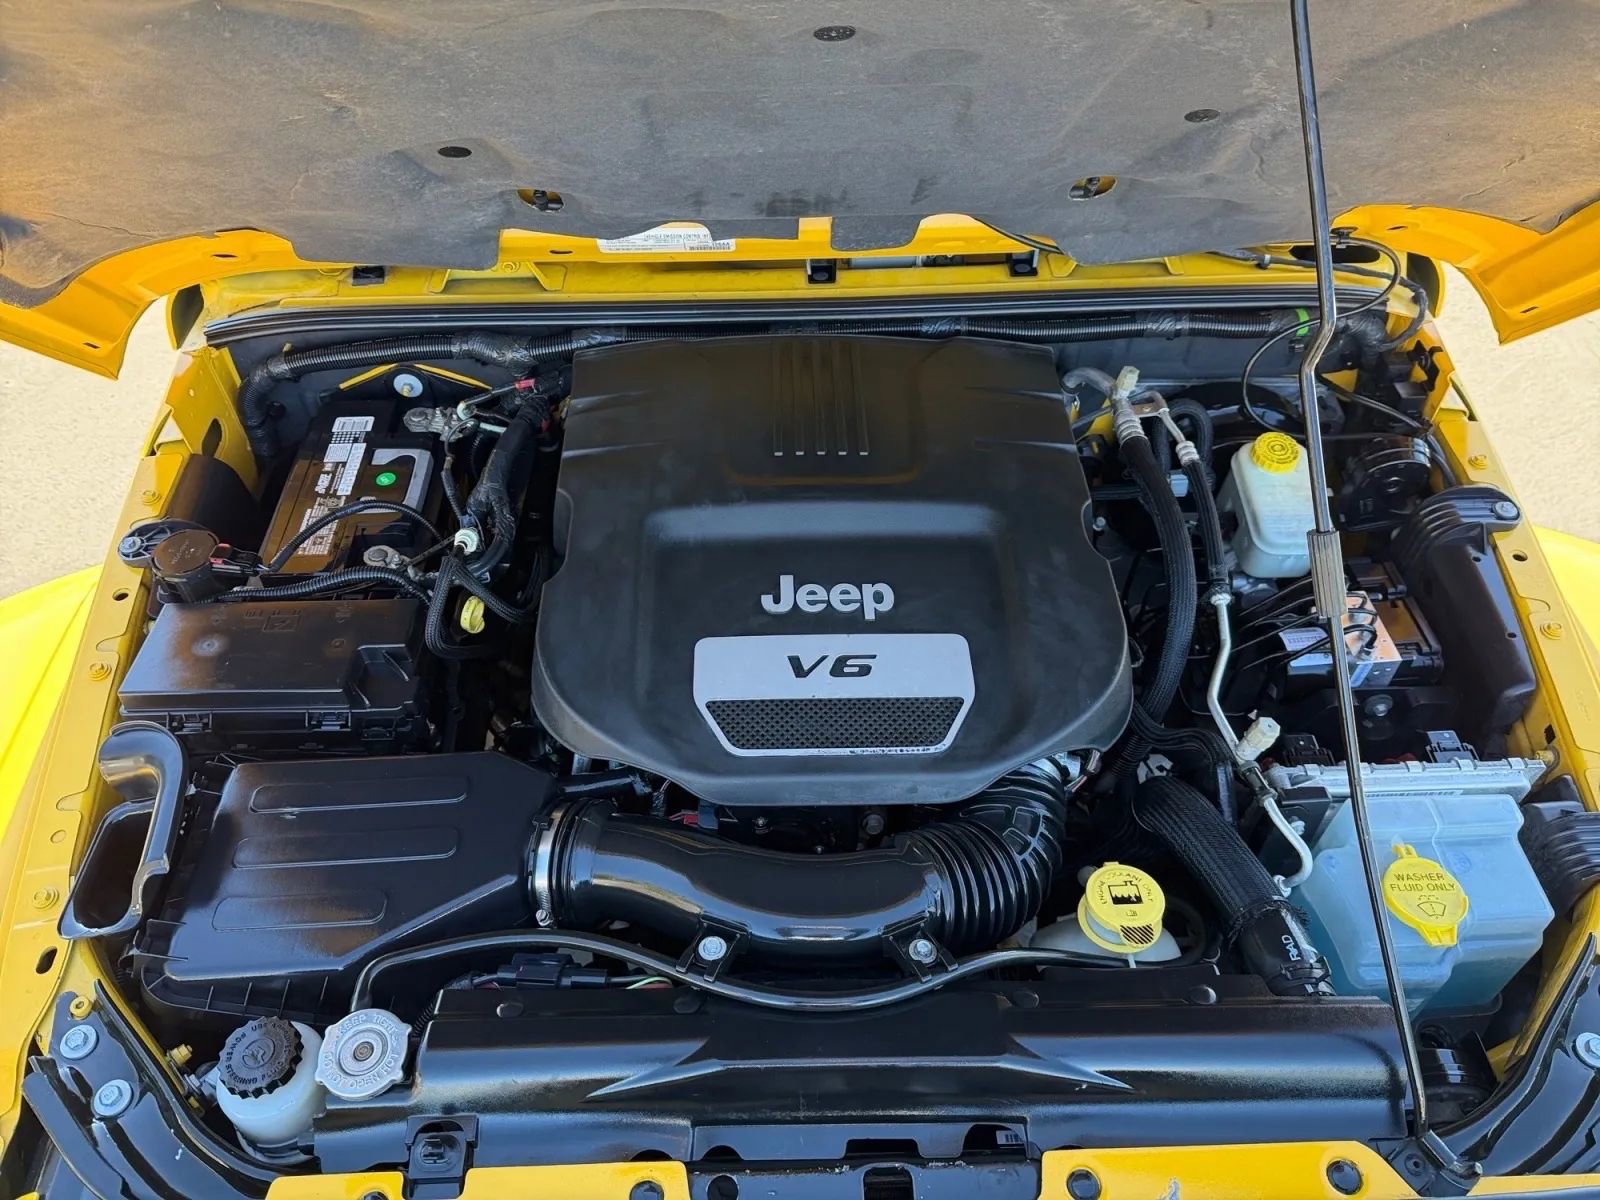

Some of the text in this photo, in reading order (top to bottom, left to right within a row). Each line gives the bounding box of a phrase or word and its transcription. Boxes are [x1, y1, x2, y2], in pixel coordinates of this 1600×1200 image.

[760, 575, 895, 621] Jeep
[787, 654, 878, 679] V6
[1389, 882, 1456, 892] FLUID ONLY
[1394, 872, 1445, 881] WASHER
[1281, 934, 1301, 961] RAD
[339, 1014, 366, 1035] KEEP
[226, 1032, 247, 1062] POWER
[225, 1063, 258, 1085] STEERING
[324, 1051, 334, 1068] DO
[350, 1071, 379, 1089] OPEN
[380, 1050, 399, 1076] HOT
